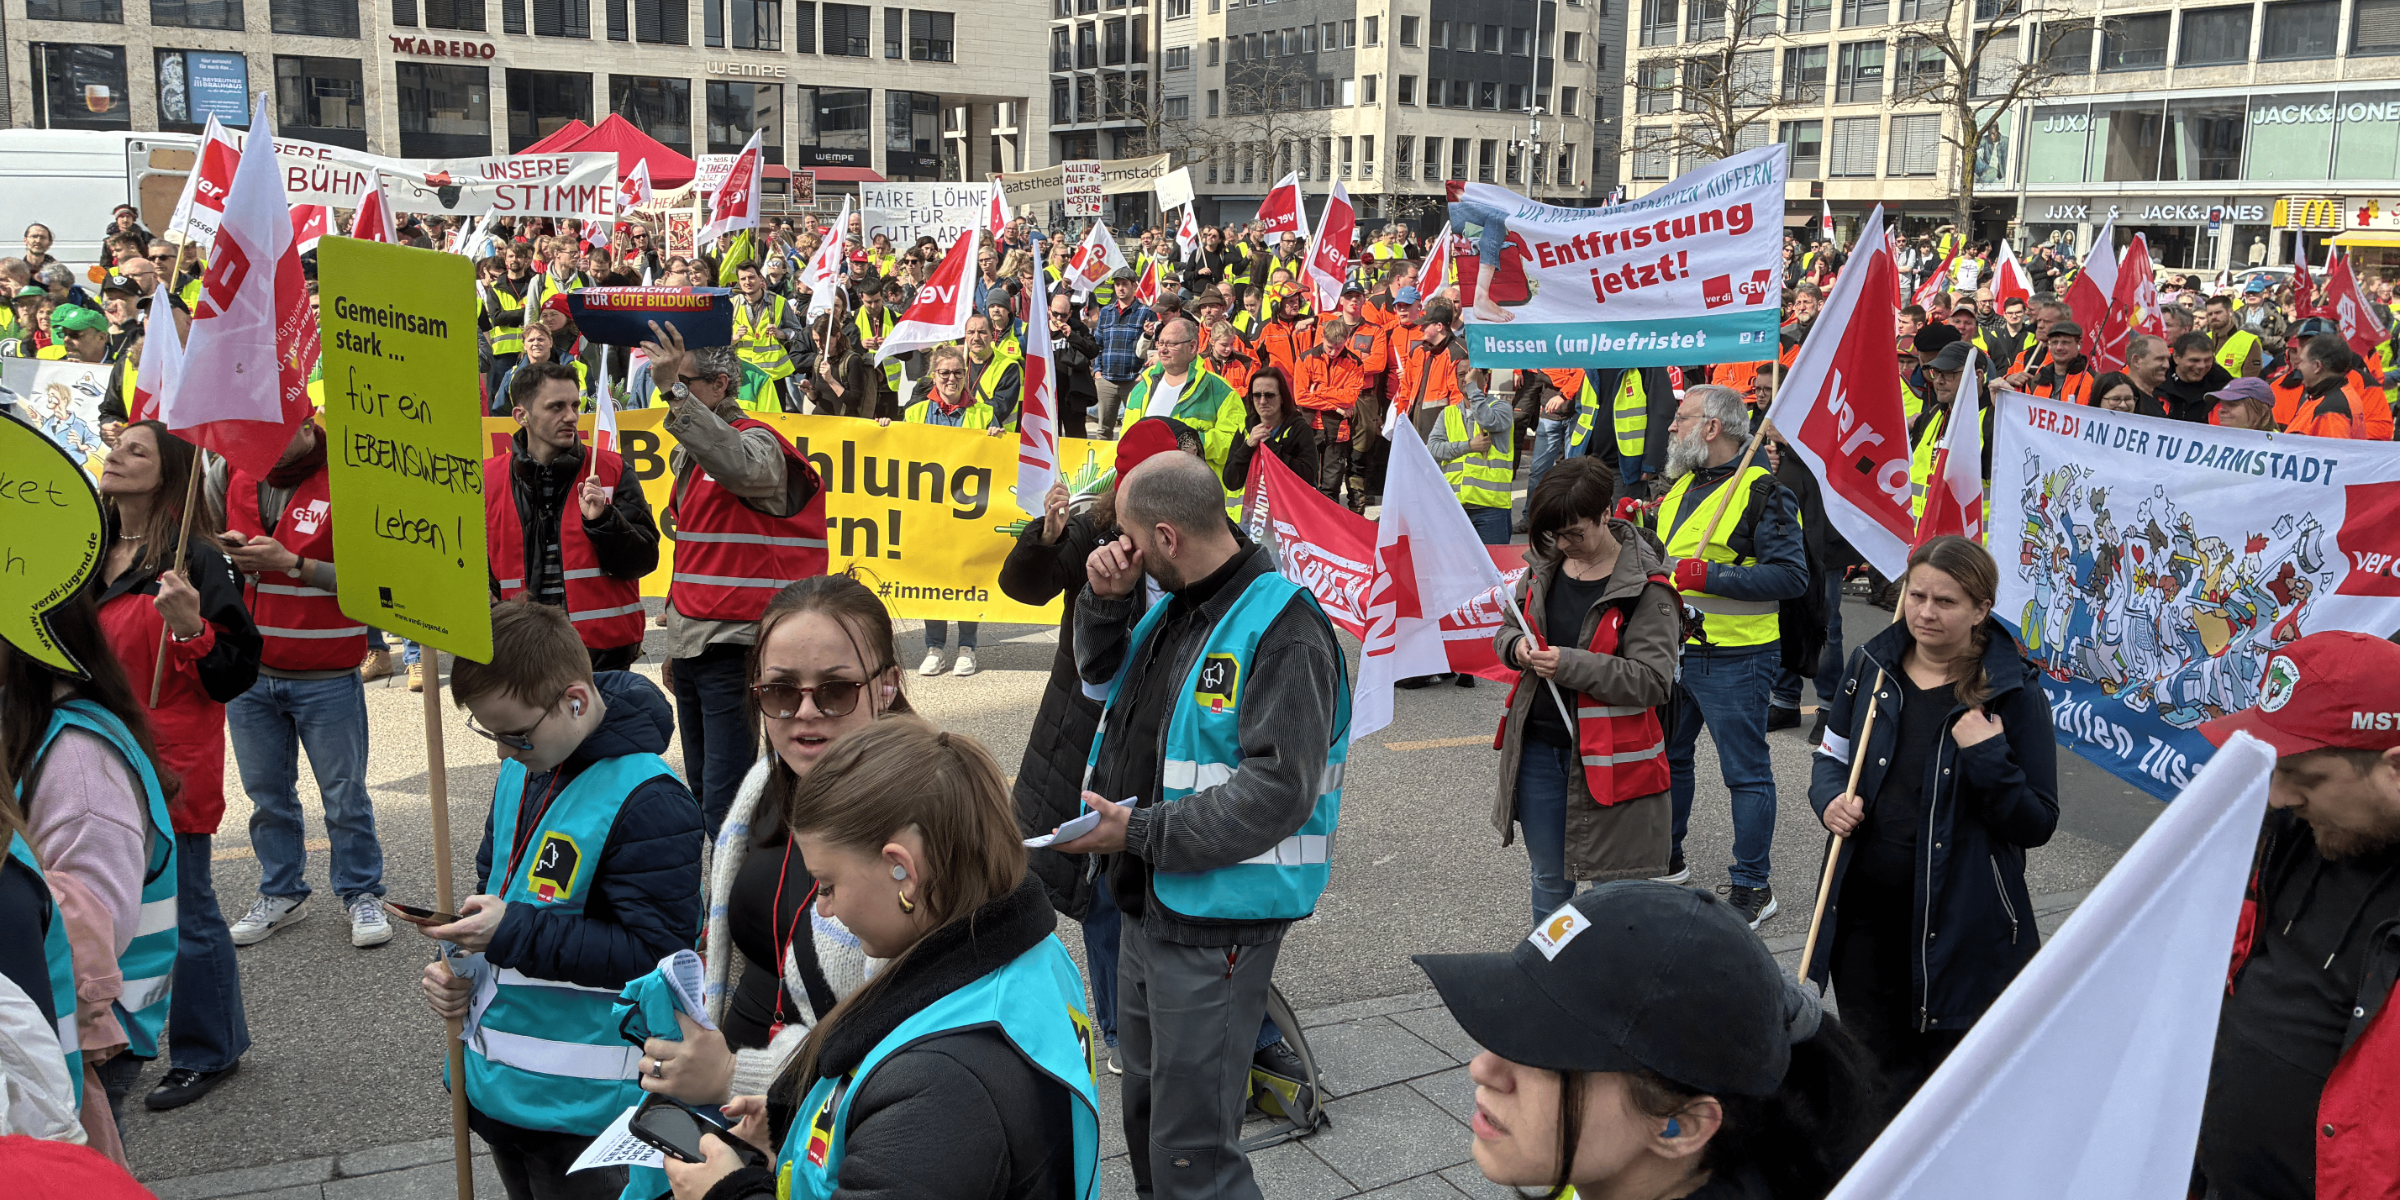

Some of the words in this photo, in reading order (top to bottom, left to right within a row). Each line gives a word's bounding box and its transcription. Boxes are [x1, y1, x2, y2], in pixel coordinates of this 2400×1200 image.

[389, 34, 496, 59] MAREDO
[706, 61, 787, 78] WEMPE
[2043, 113, 2097, 134] JJXX
[815, 153, 855, 162] WEMPE
[919, 158, 937, 166] WEMPE
[481, 158, 570, 180] UNSERE
[1065, 164, 1101, 174] KULTUR
[1065, 174, 1086, 183] AUF
[1100, 164, 1164, 182] armstadt
[1066, 185, 1102, 195] UNSERE
[1706, 160, 1777, 200] KOFFERN.
[493, 184, 614, 216] STIMME
[932, 187, 988, 208] LÖHNE
[1067, 195, 1101, 204] KOSTEN
[910, 206, 944, 223] FÜR
[2044, 204, 2087, 219] JJXX
[2108, 204, 2120, 219] &
[2140, 204, 2264, 220] JACK&JONES
[1535, 202, 1754, 269] Entfristung
[1590, 250, 1690, 304] jetzt!
[1739, 280, 1771, 295] GEW
[611, 294, 643, 307] GUTE
[647, 294, 711, 308] BILDUNG!
[335, 296, 448, 339] Gemeinsam
[336, 329, 383, 357] stark
[1484, 335, 1548, 354] Hessen
[1555, 329, 1707, 356] (un)befristet
[346, 365, 390, 417] für
[398, 392, 432, 424] ein
[2027, 405, 2080, 439] VER.DI
[2084, 420, 2109, 446] AN
[2113, 426, 2150, 455] DER
[2156, 434, 2182, 461] TU
[2184, 440, 2338, 486] DARMSTADT
[344, 425, 482, 495] LEBENSWERTES
[292, 507, 328, 525] GEW
[877, 581, 989, 602] #immerda
[2138, 735, 2205, 791] zus
